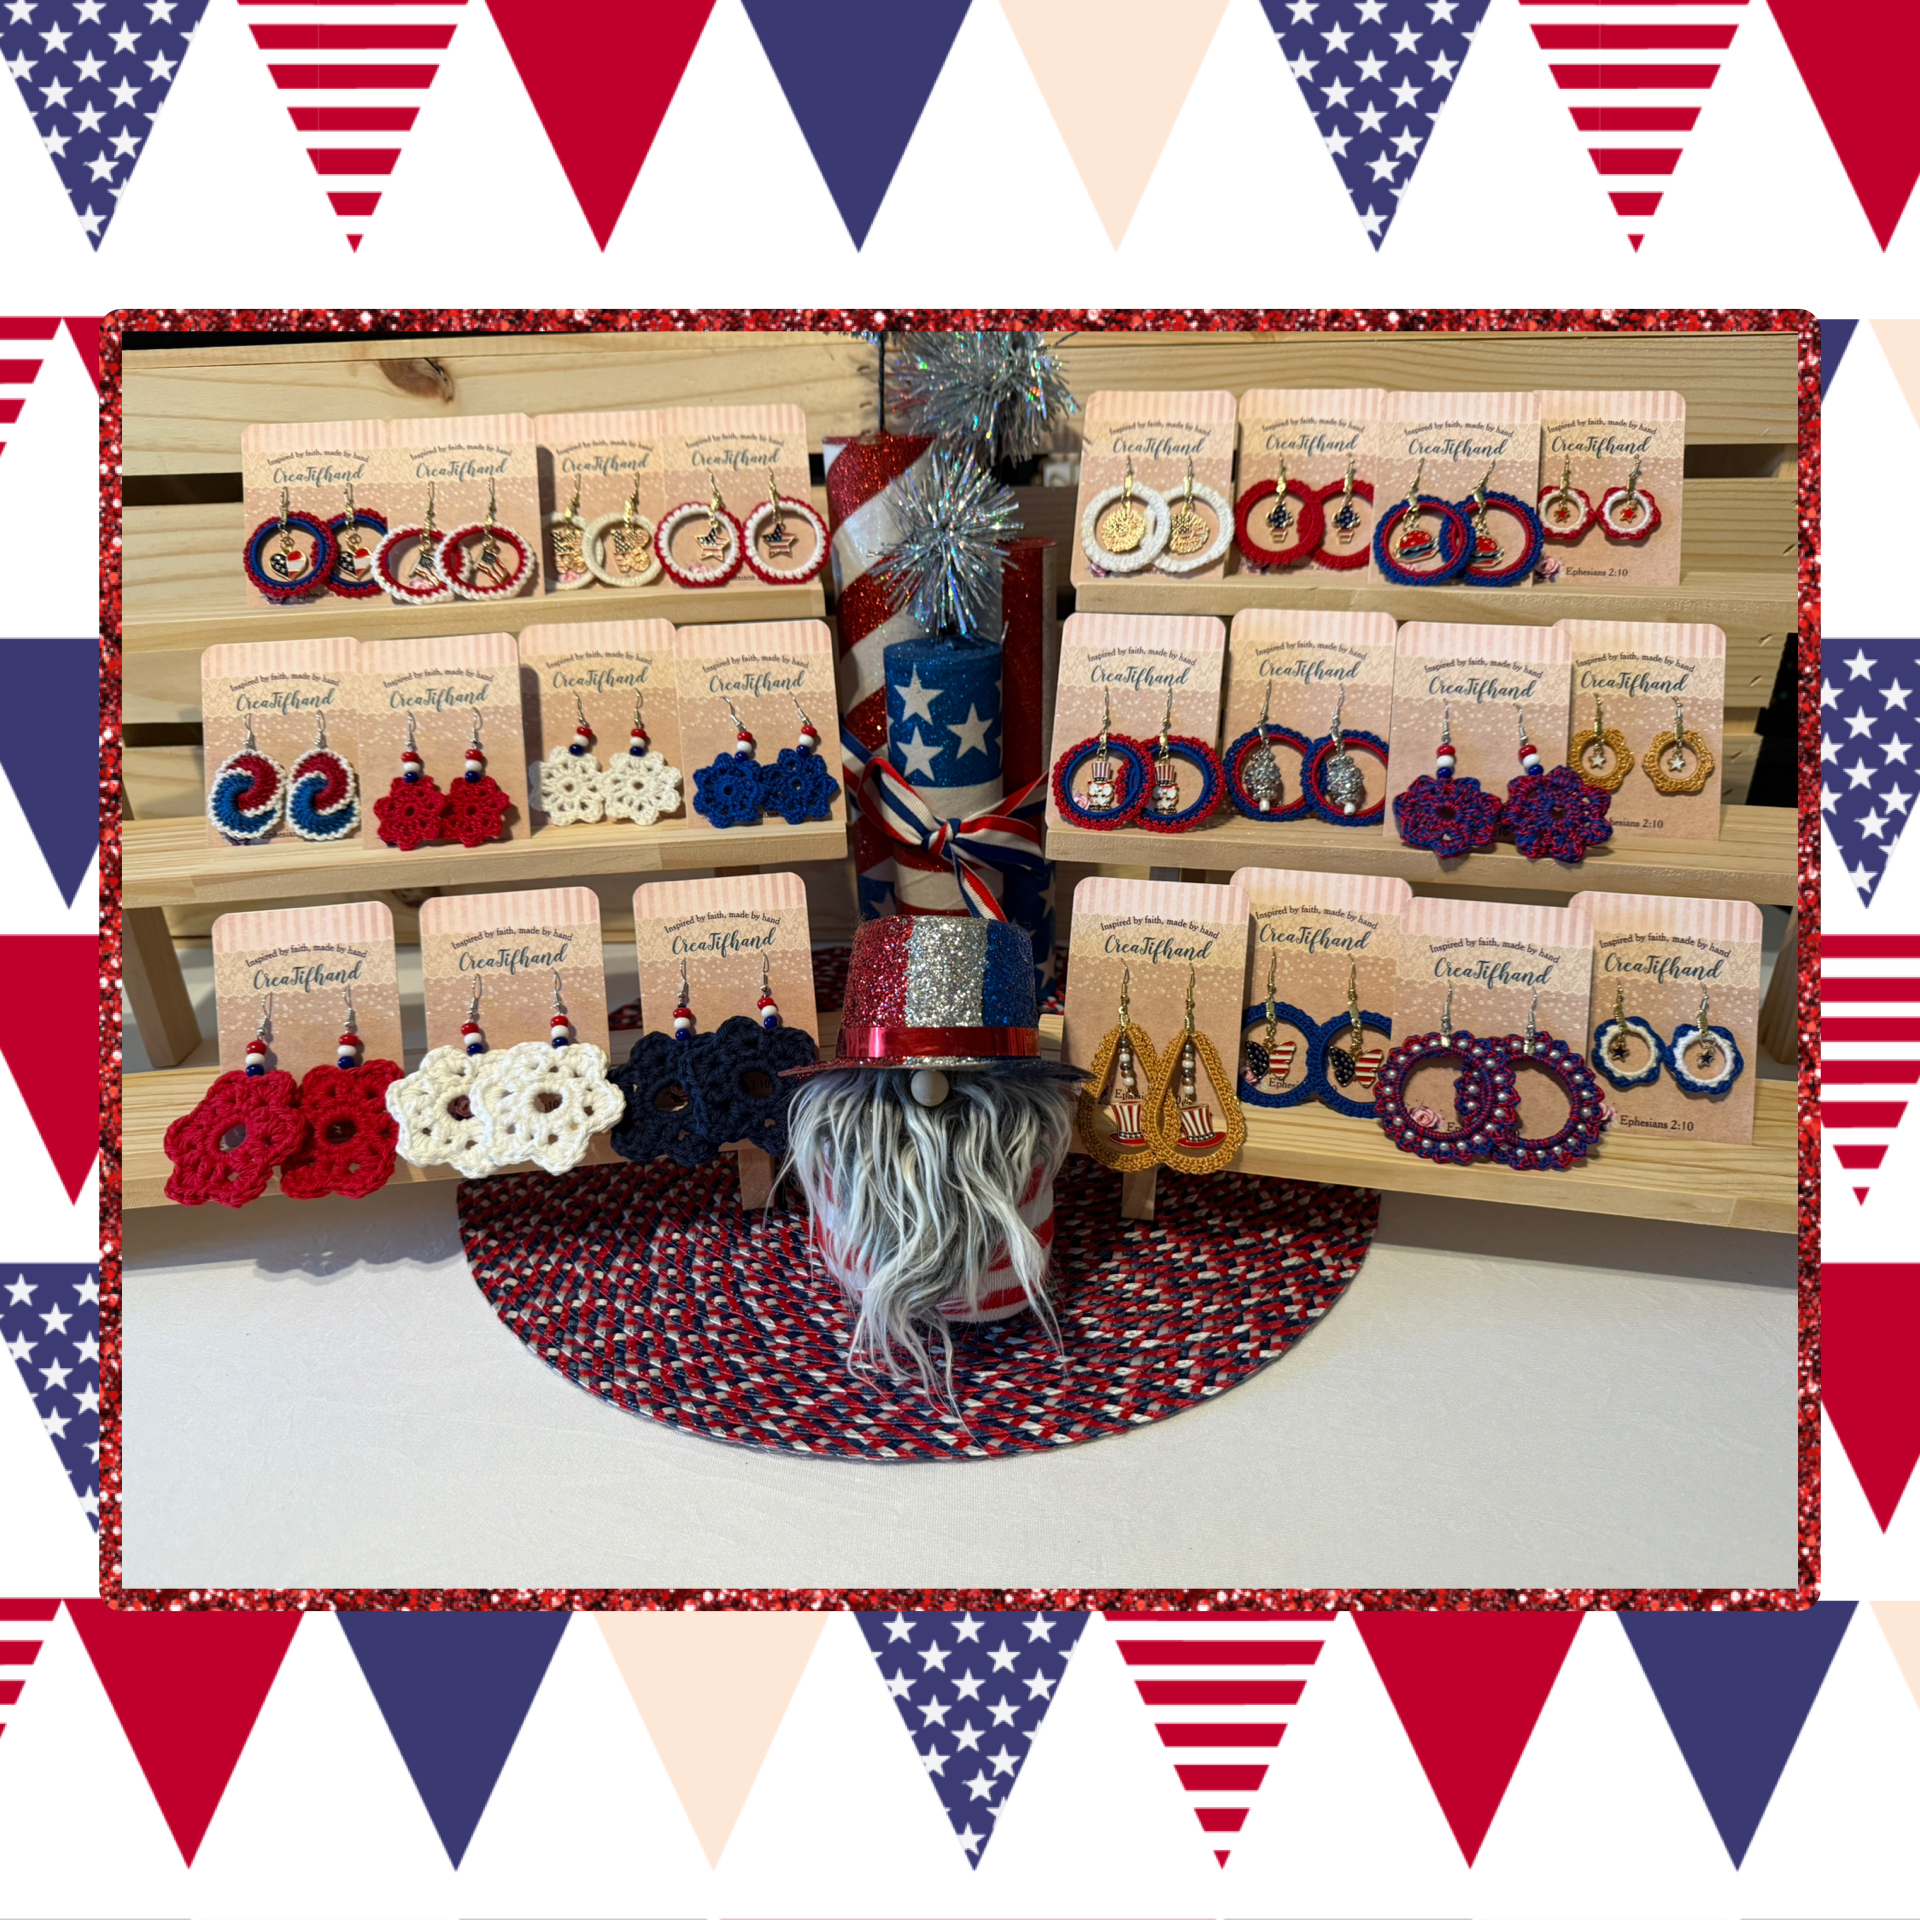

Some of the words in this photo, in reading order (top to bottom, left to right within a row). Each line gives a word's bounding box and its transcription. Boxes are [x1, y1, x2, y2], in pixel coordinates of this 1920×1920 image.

[1261, 418, 1288, 432] Inspired
[1338, 419, 1347, 428] by
[1347, 421, 1364, 433] hand
[1404, 422, 1432, 436] Inspired
[1434, 421, 1443, 429] by
[1485, 423, 1494, 432] by
[1495, 425, 1513, 438] hand
[1547, 419, 1575, 433] Inspired
[1576, 419, 1586, 427] by
[1628, 420, 1637, 429] by
[1638, 423, 1656, 435] hand
[267, 452, 294, 466] Inspired
[343, 450, 351, 458] by
[352, 452, 369, 462] hand
[410, 446, 437, 460] Inspired
[486, 444, 494, 452] by
[495, 446, 512, 456] hand
[1566, 567, 1606, 576] Ephesians
[1608, 568, 1628, 576] 2:10
[546, 653, 574, 669] Inspired
[574, 652, 584, 660] by
[585, 650, 603, 658] faith,
[625, 651, 634, 660] by
[635, 653, 653, 665] hand
[1087, 648, 1116, 662] Inspired
[1117, 647, 1126, 656] by
[1128, 646, 1146, 654] faith,
[1168, 650, 1178, 660] by
[1178, 653, 1196, 666] hand
[1255, 642, 1284, 656] Inspired
[1286, 641, 1295, 650] by
[1297, 640, 1315, 648] faith,
[1338, 644, 1348, 654] by
[1348, 647, 1366, 660] hand
[702, 657, 730, 673] Inspired
[730, 656, 740, 664] by
[741, 653, 759, 662] faith,
[782, 655, 790, 664] by
[791, 657, 809, 669] hand
[1424, 658, 1455, 673] Inspired
[1456, 658, 1466, 667] by
[1468, 657, 1487, 665] faith,
[1490, 660, 1510, 668] made
[1512, 661, 1522, 672] by
[1523, 664, 1542, 679] hand
[1576, 653, 1606, 667] Inspired
[1608, 652, 1618, 661] by
[1620, 651, 1639, 660] faith,
[1664, 655, 1674, 666] by
[1674, 659, 1694, 673] hand
[230, 676, 259, 692] Inspired
[259, 675, 269, 683] by
[270, 671, 289, 680] faith,
[312, 672, 321, 682] by
[322, 674, 340, 686] hand
[383, 672, 412, 688] Inspired
[412, 671, 422, 679] by
[424, 667, 442, 676] faith,
[466, 668, 474, 678] by
[476, 670, 494, 682] hand
[1609, 818, 1640, 827] hesians
[1642, 819, 1664, 828] 2:10
[664, 915, 695, 933] Inspired
[695, 914, 705, 922] by
[707, 910, 726, 920] faith,
[728, 910, 748, 918] made
[751, 911, 760, 921] by
[761, 912, 781, 925] hand
[1100, 916, 1131, 931] Inspired
[1132, 915, 1142, 925] by
[1144, 915, 1164, 924] faith,
[1166, 918, 1186, 927] made
[1188, 920, 1198, 931] by
[1199, 924, 1218, 940] hand
[1256, 905, 1287, 919] Inspired
[1289, 905, 1299, 914] by
[1301, 905, 1321, 914] faith,
[1323, 908, 1344, 917] made
[1346, 910, 1357, 921] by
[1357, 914, 1378, 930] hand
[451, 931, 483, 949] Inspired
[483, 930, 494, 939] by
[496, 926, 516, 936] faith,
[518, 926, 539, 934] made
[542, 926, 551, 937] by
[553, 928, 573, 941] hand
[1599, 933, 1633, 948] Inspired
[1634, 932, 1645, 943] by
[1648, 932, 1669, 942] faith,
[1672, 936, 1694, 945] made
[1696, 938, 1708, 950] by
[1708, 942, 1730, 958] hand
[245, 948, 278, 967] Inspired
[278, 947, 288, 956] by
[290, 943, 310, 953] faith,
[313, 943, 334, 951] made
[336, 943, 346, 954] by
[347, 945, 368, 958] hand
[1429, 938, 1463, 953] Inspired
[1465, 937, 1476, 948] by
[1478, 937, 1499, 947] faith,
[1502, 941, 1524, 950] made
[1526, 943, 1537, 955] by
[1538, 947, 1559, 964] hand
[1620, 1115, 1668, 1129] Ephesians
[1671, 1120, 1694, 1131] 2:10
